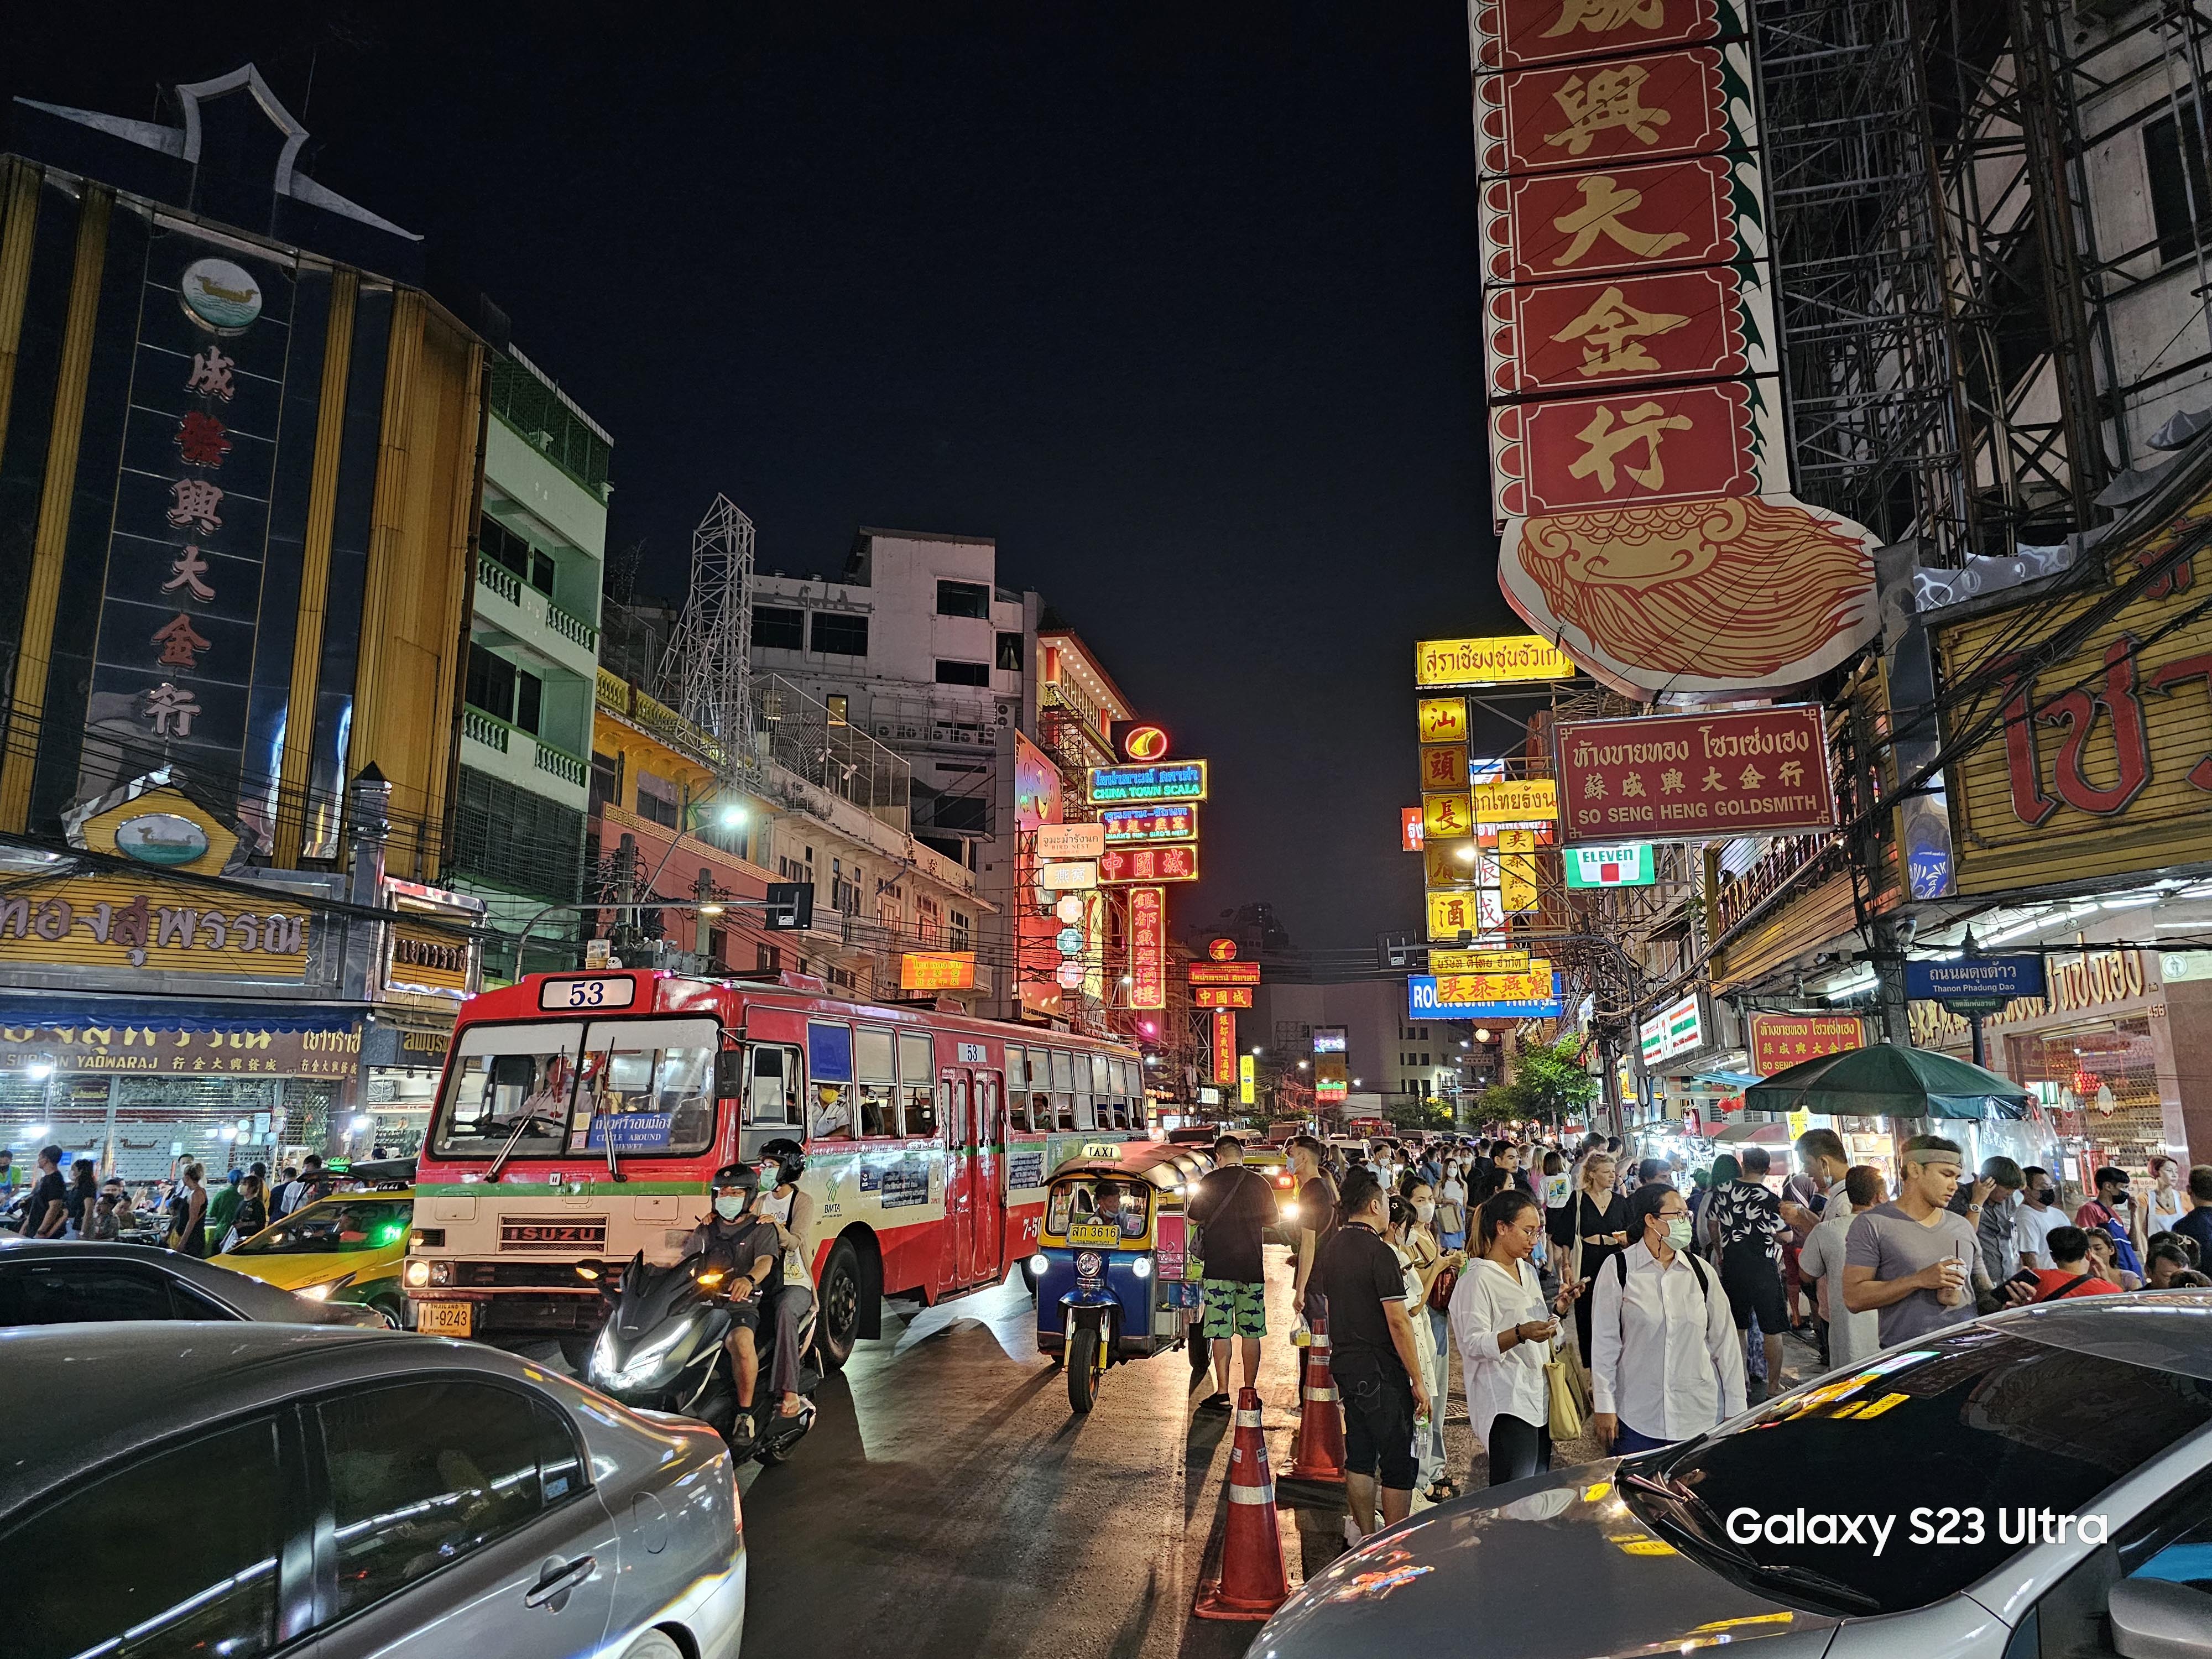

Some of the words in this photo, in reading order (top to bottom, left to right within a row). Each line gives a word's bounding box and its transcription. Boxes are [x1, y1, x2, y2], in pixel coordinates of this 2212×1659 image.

[1574, 739, 1689, 768] ห้างขายทอง
[1698, 724, 1810, 759] โซวเซ่งเฮง
[1583, 761, 1805, 800] 蘇成興大金行
[1093, 789, 1127, 800] CHINA
[1129, 786, 1162, 797] TOWN
[1163, 784, 1200, 795] SCALA
[1578, 808, 1601, 825] SO
[1608, 805, 1653, 822] SENG
[1661, 802, 1708, 820] HENG
[1714, 795, 1817, 816] GOLDSMITH
[1929, 961, 2017, 984] ถนนผดุงด้าว
[569, 982, 604, 1006] 53
[1963, 984, 1997, 993] Phadung
[967, 1045, 977, 1061] 53
[77, 1055, 158, 1069] YAOWARAJ
[1762, 1061, 1772, 1070] SO
[1088, 1146, 1114, 1157] TAXI
[825, 1203, 841, 1214] BMTA
[510, 1228, 596, 1240] ISUZU
[1072, 1227, 1087, 1237] สก
[1091, 1227, 1116, 1238] 3616
[423, 1310, 467, 1327] 11-9243
